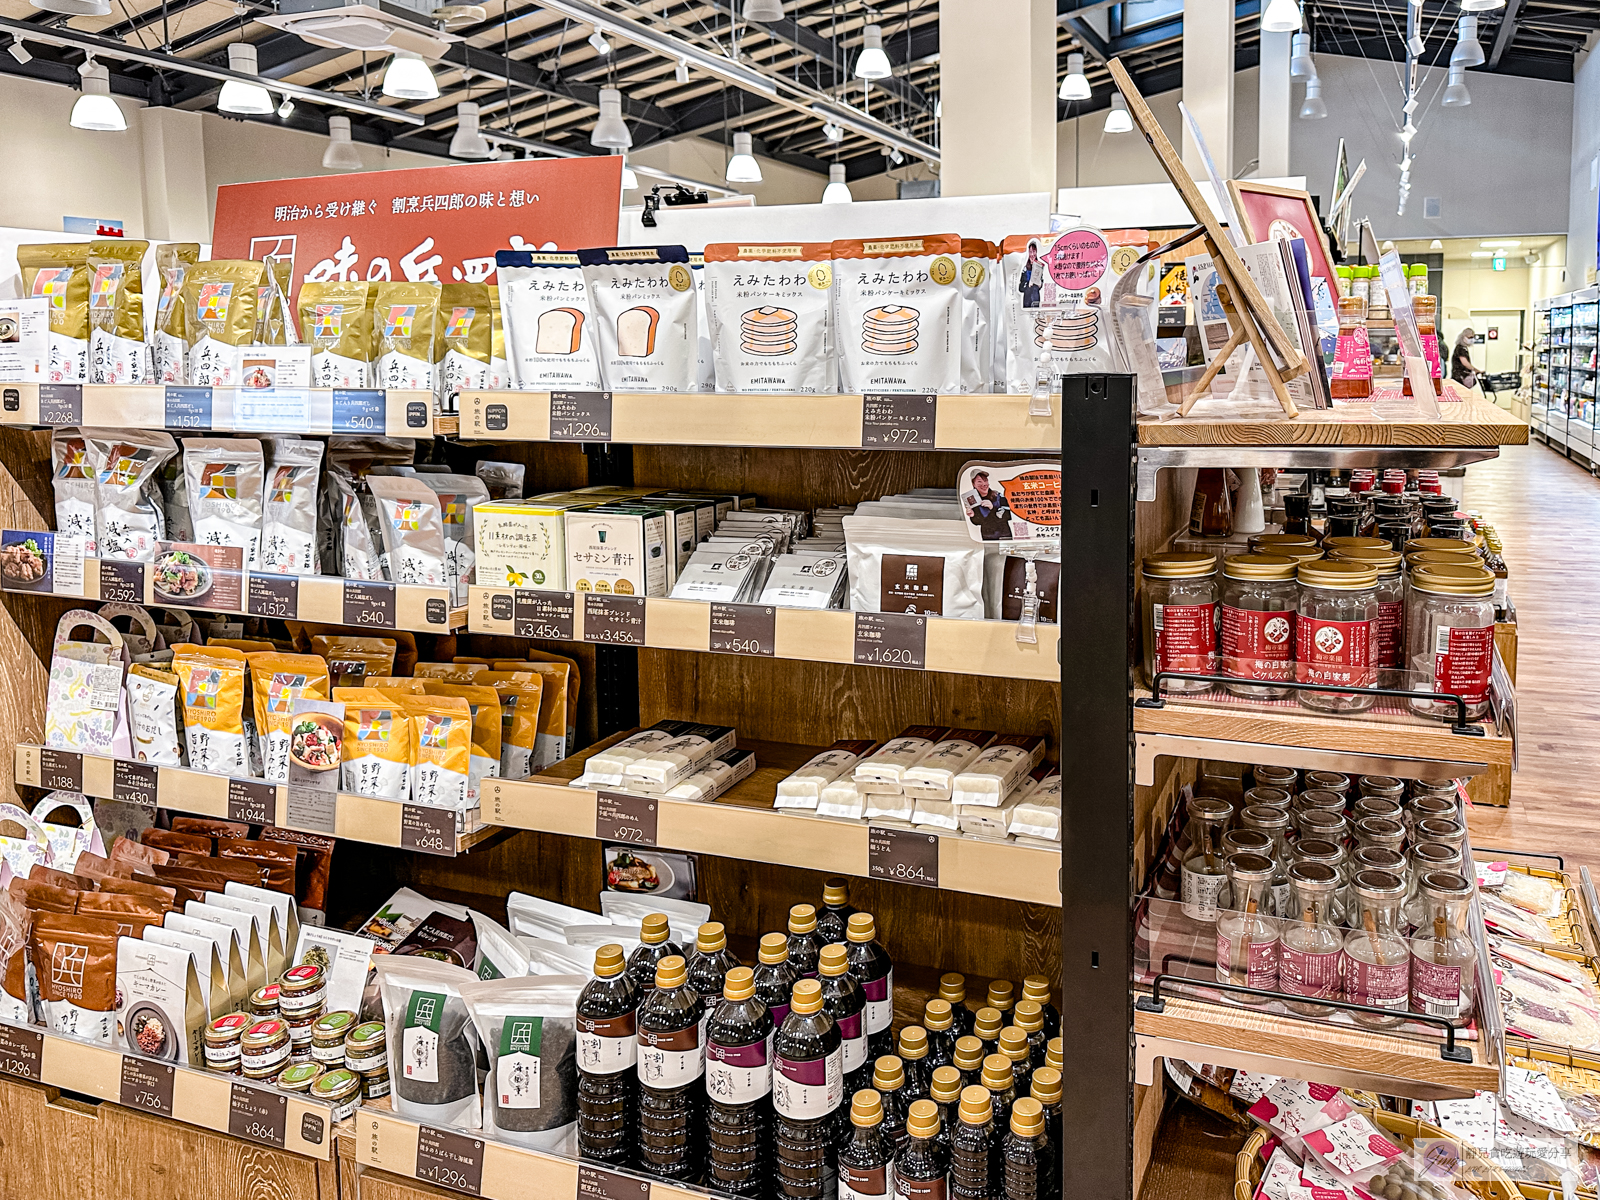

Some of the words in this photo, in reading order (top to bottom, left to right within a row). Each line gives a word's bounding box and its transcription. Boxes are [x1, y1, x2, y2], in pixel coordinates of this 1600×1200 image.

[273, 199, 378, 223] 明治から受け継ぐ
[391, 189, 540, 215] 割烹兵四郎の味と想い
[1053, 240, 1101, 251] 15cmくらいのものが
[610, 276, 669, 290] えみたわわ
[732, 274, 807, 288] えみたわわ
[857, 270, 929, 286] えみたわわ
[736, 290, 804, 299] 米粉パンケーキミックス
[860, 288, 928, 297] 米粉パンケーキミックス
[750, 377, 786, 385] EMITAWAWA
[870, 377, 907, 385] EMITAWAWA
[44, 411, 73, 424] ¥2,268
[172, 415, 201, 428] ¥1,512
[345, 416, 374, 429] ¥540
[864, 414, 928, 422] 米粉パンケーキミックス
[562, 422, 600, 437] ¥1,296
[883, 428, 919, 444] ¥972
[105, 520, 127, 554] 減塩
[573, 551, 635, 566] セサミン青汁
[894, 583, 929, 592] 玄米珈琲
[104, 588, 135, 602] ¥2,592
[256, 602, 286, 616] ¥1,512
[356, 610, 384, 625] ¥540
[712, 618, 735, 626] 玄米珈琲
[520, 623, 560, 638] ¥3,456
[599, 629, 633, 643] ¥3,456
[857, 630, 882, 639] 玄米珈琲
[725, 638, 760, 654] ¥540
[1264, 643, 1289, 651] 梅の楽園
[866, 647, 912, 664] ¥1,620
[1315, 653, 1343, 663] 梅の楽園
[1307, 667, 1351, 682] 梅の自家製
[186, 708, 217, 717] HYOSHIRO
[201, 715, 217, 723] 1900
[48, 775, 73, 789] ¥1,188
[125, 791, 149, 805] ¥430
[235, 808, 265, 823] ¥1,944
[613, 826, 643, 842] ¥972
[415, 835, 443, 850] ¥648
[888, 863, 925, 880] ¥864
[51, 983, 83, 995] HYOSHIRO
[132, 980, 167, 993] キーマカレー
[51, 989, 67, 998] SINCE
[66, 992, 83, 1000] 1900
[134, 1090, 161, 1109] ¥756
[245, 1121, 275, 1141] ¥864
[371, 1133, 379, 1155] 旅の駅
[427, 1165, 467, 1188] ¥1,296
